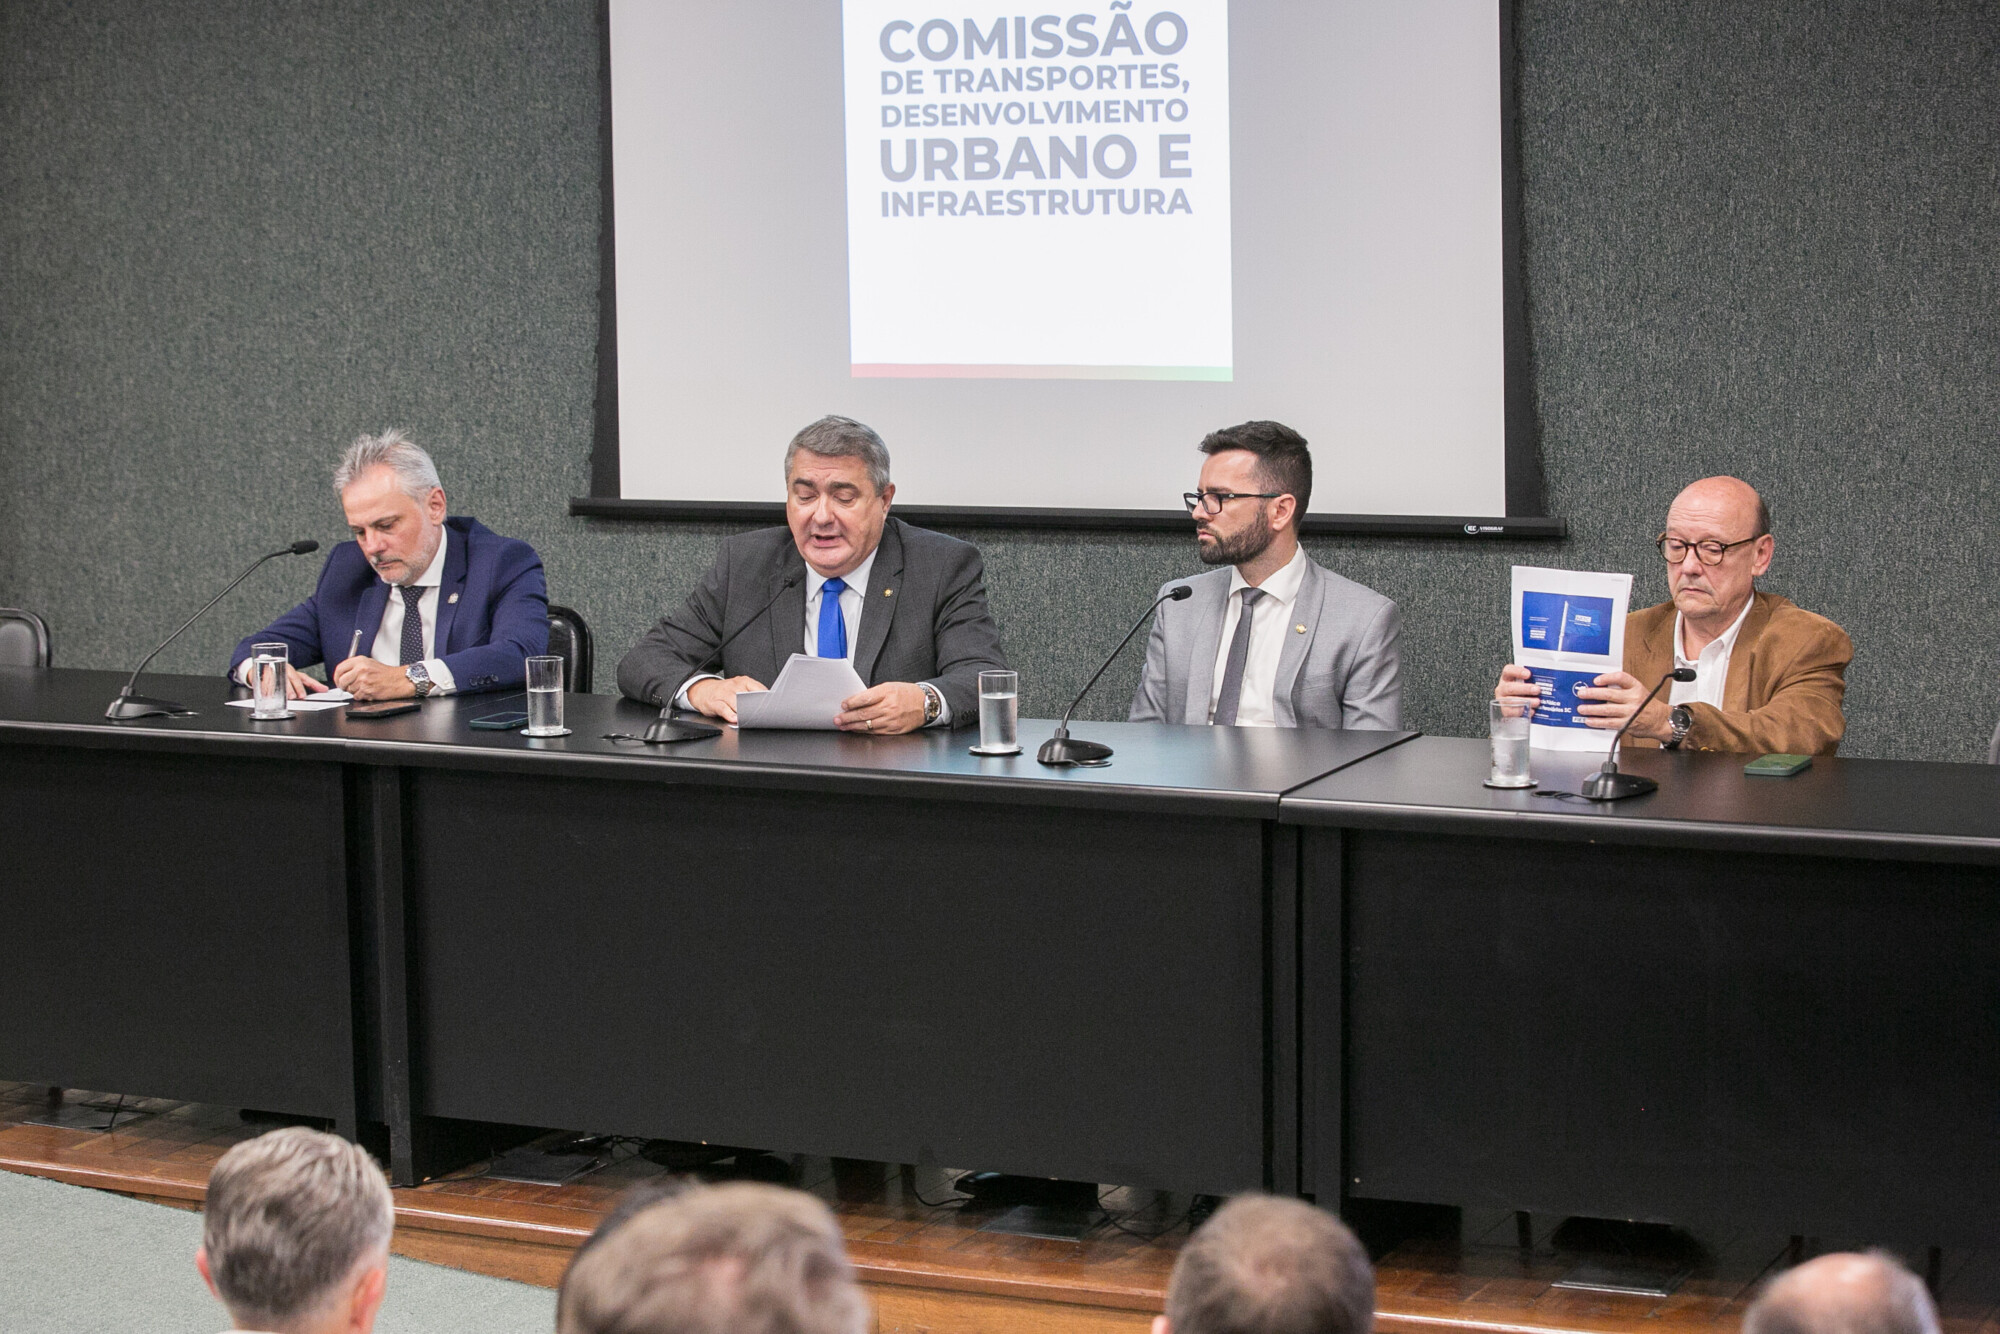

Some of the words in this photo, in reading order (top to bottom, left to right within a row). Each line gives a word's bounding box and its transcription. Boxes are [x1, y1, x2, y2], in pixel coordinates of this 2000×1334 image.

[879, 0, 1189, 63] COMISSÃO
[881, 70, 924, 95] DE
[933, 63, 1190, 94] TRANSPORTES,
[881, 98, 1189, 128] DESENVOLVIMENTO
[880, 134, 1138, 182] URBANO
[1158, 133, 1193, 178] E
[881, 188, 1193, 218] INFRAESTRUTURA
